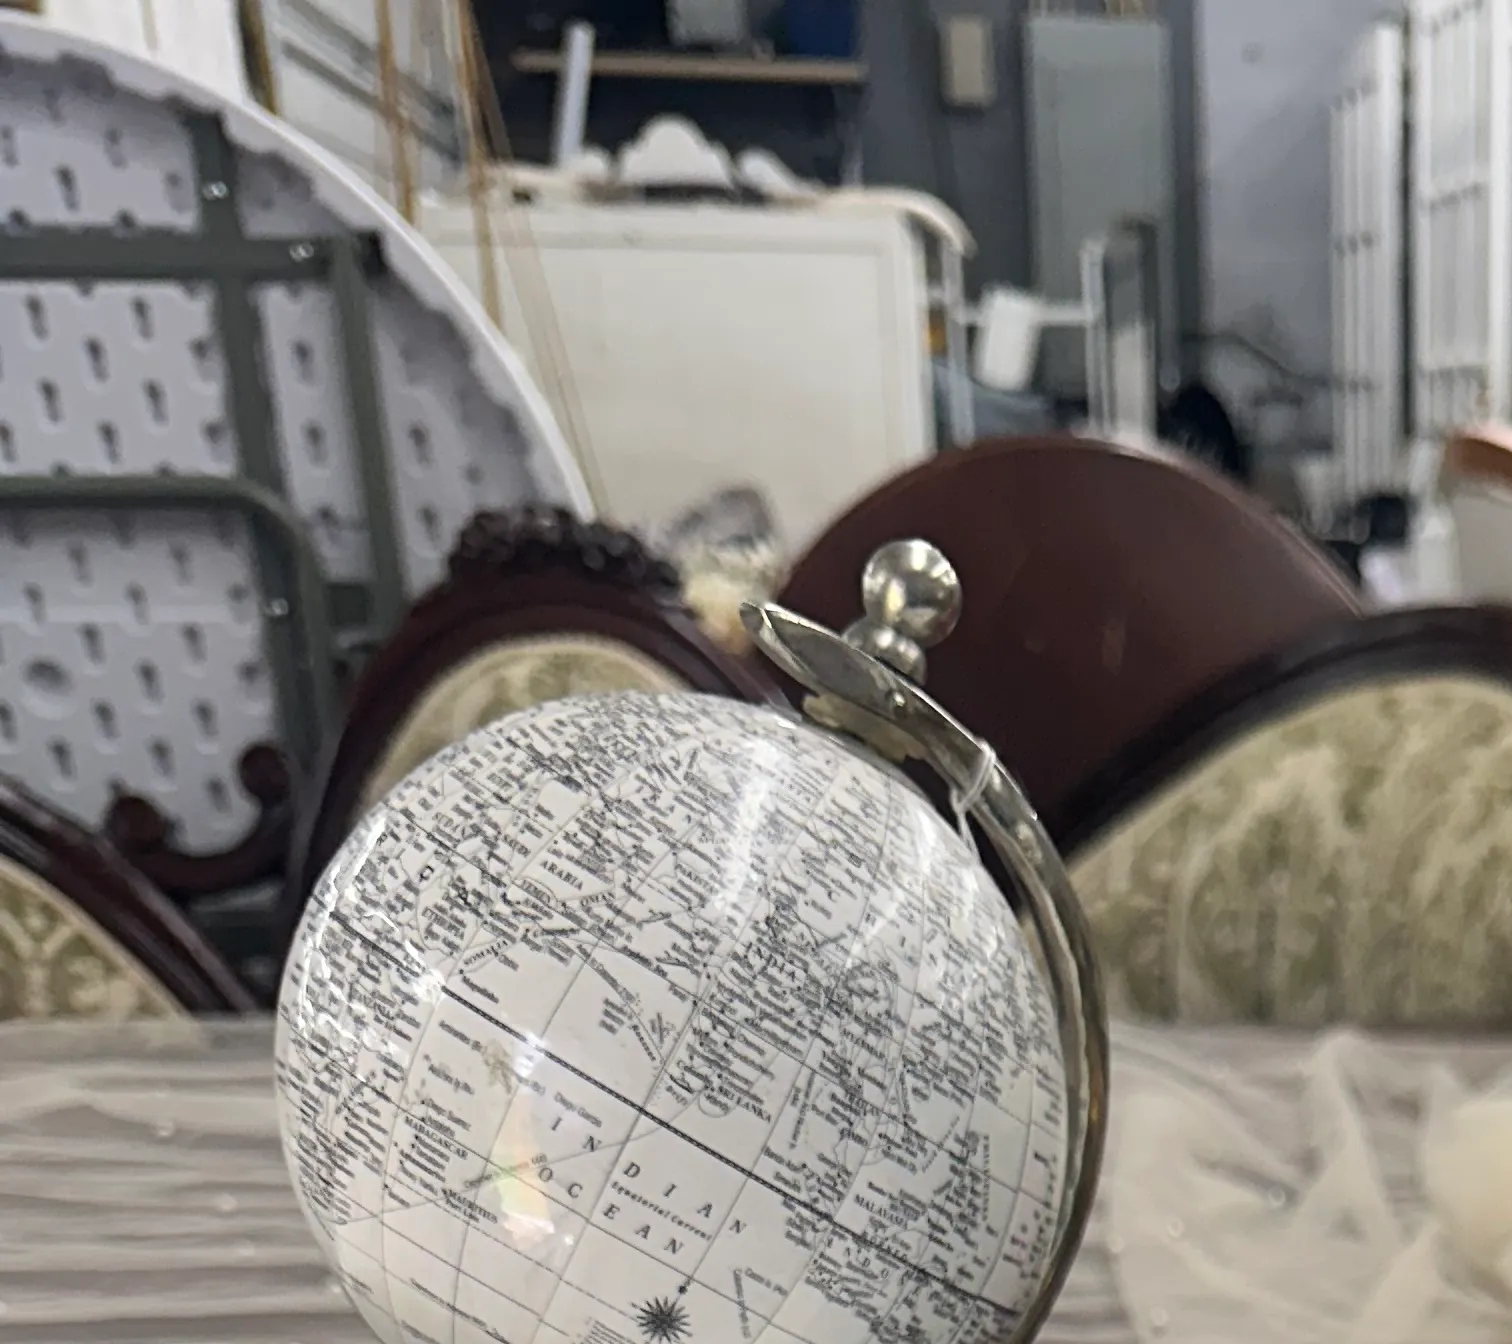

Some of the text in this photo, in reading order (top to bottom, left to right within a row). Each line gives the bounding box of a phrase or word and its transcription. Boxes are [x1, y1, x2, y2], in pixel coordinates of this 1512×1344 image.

[541, 859, 584, 891] ARABIA
[404, 1116, 468, 1160] MADAGASCAR
[551, 1117, 748, 1235] INDIAN
[538, 1166, 684, 1255] OCEAN
[610, 1180, 713, 1242] Equatorial Current
